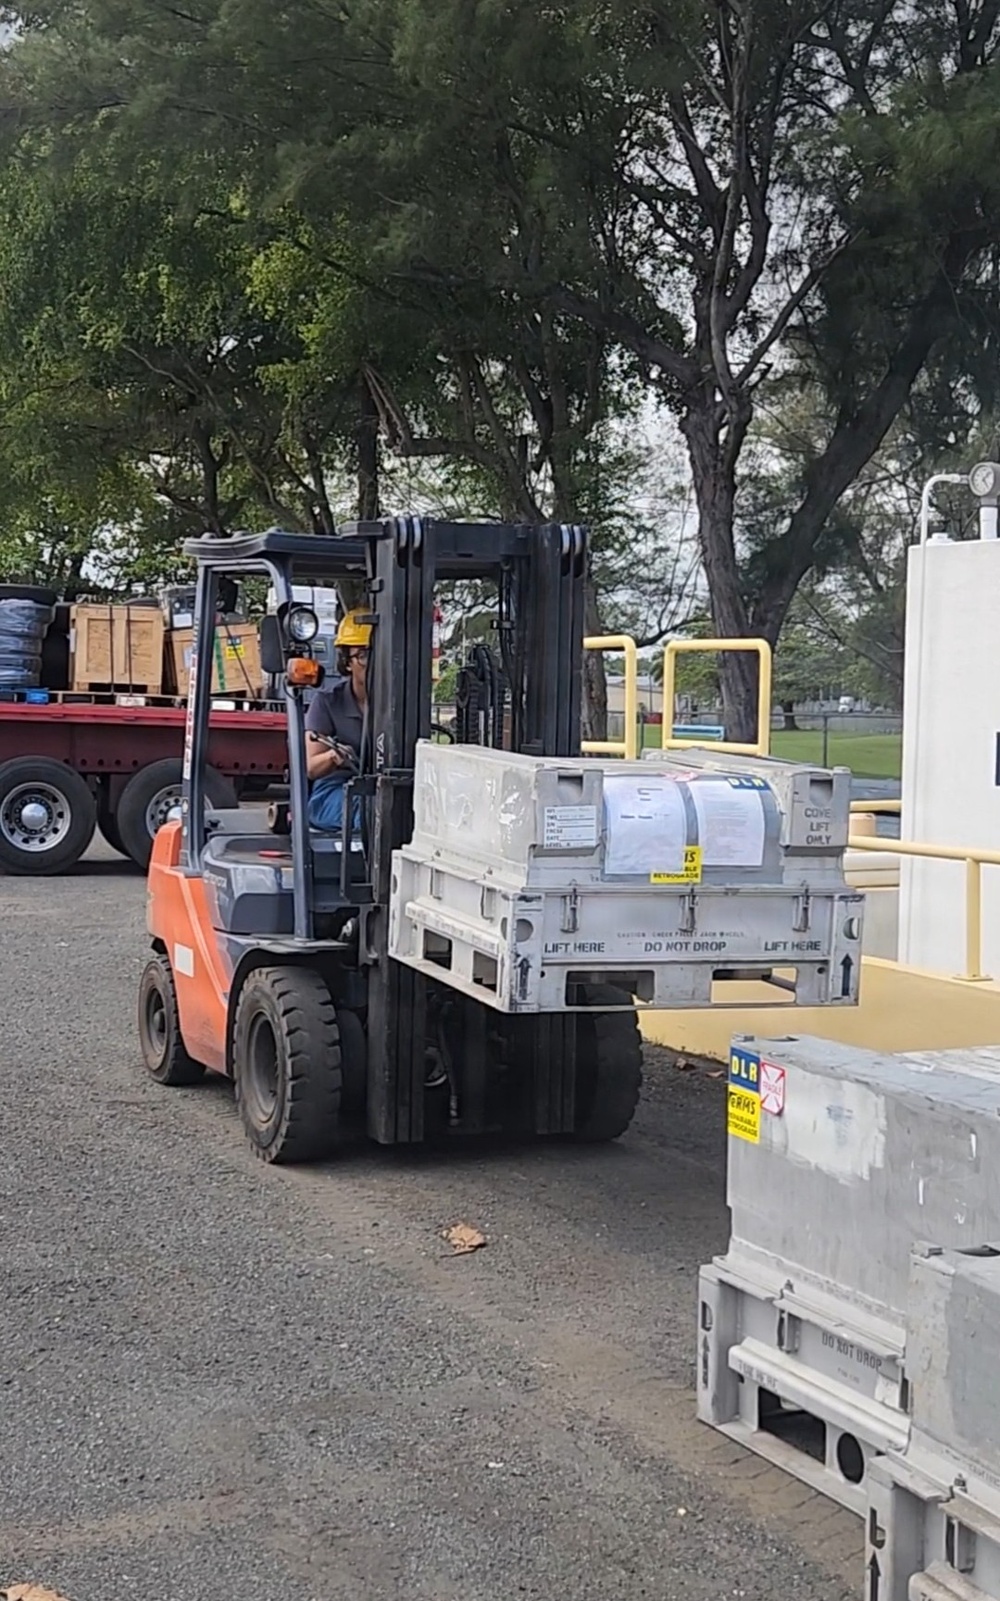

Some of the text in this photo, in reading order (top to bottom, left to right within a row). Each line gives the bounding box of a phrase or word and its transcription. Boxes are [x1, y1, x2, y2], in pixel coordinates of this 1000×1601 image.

[810, 822, 829, 832] LIFT
[806, 835, 832, 845] ONLY
[544, 942, 605, 953] LIFT HERE
[644, 941, 727, 952] DO NOT DROP
[764, 941, 821, 951] LIFT HERE
[731, 1055, 758, 1083] DLR
[822, 1331, 882, 1373] DO NOT DROP
